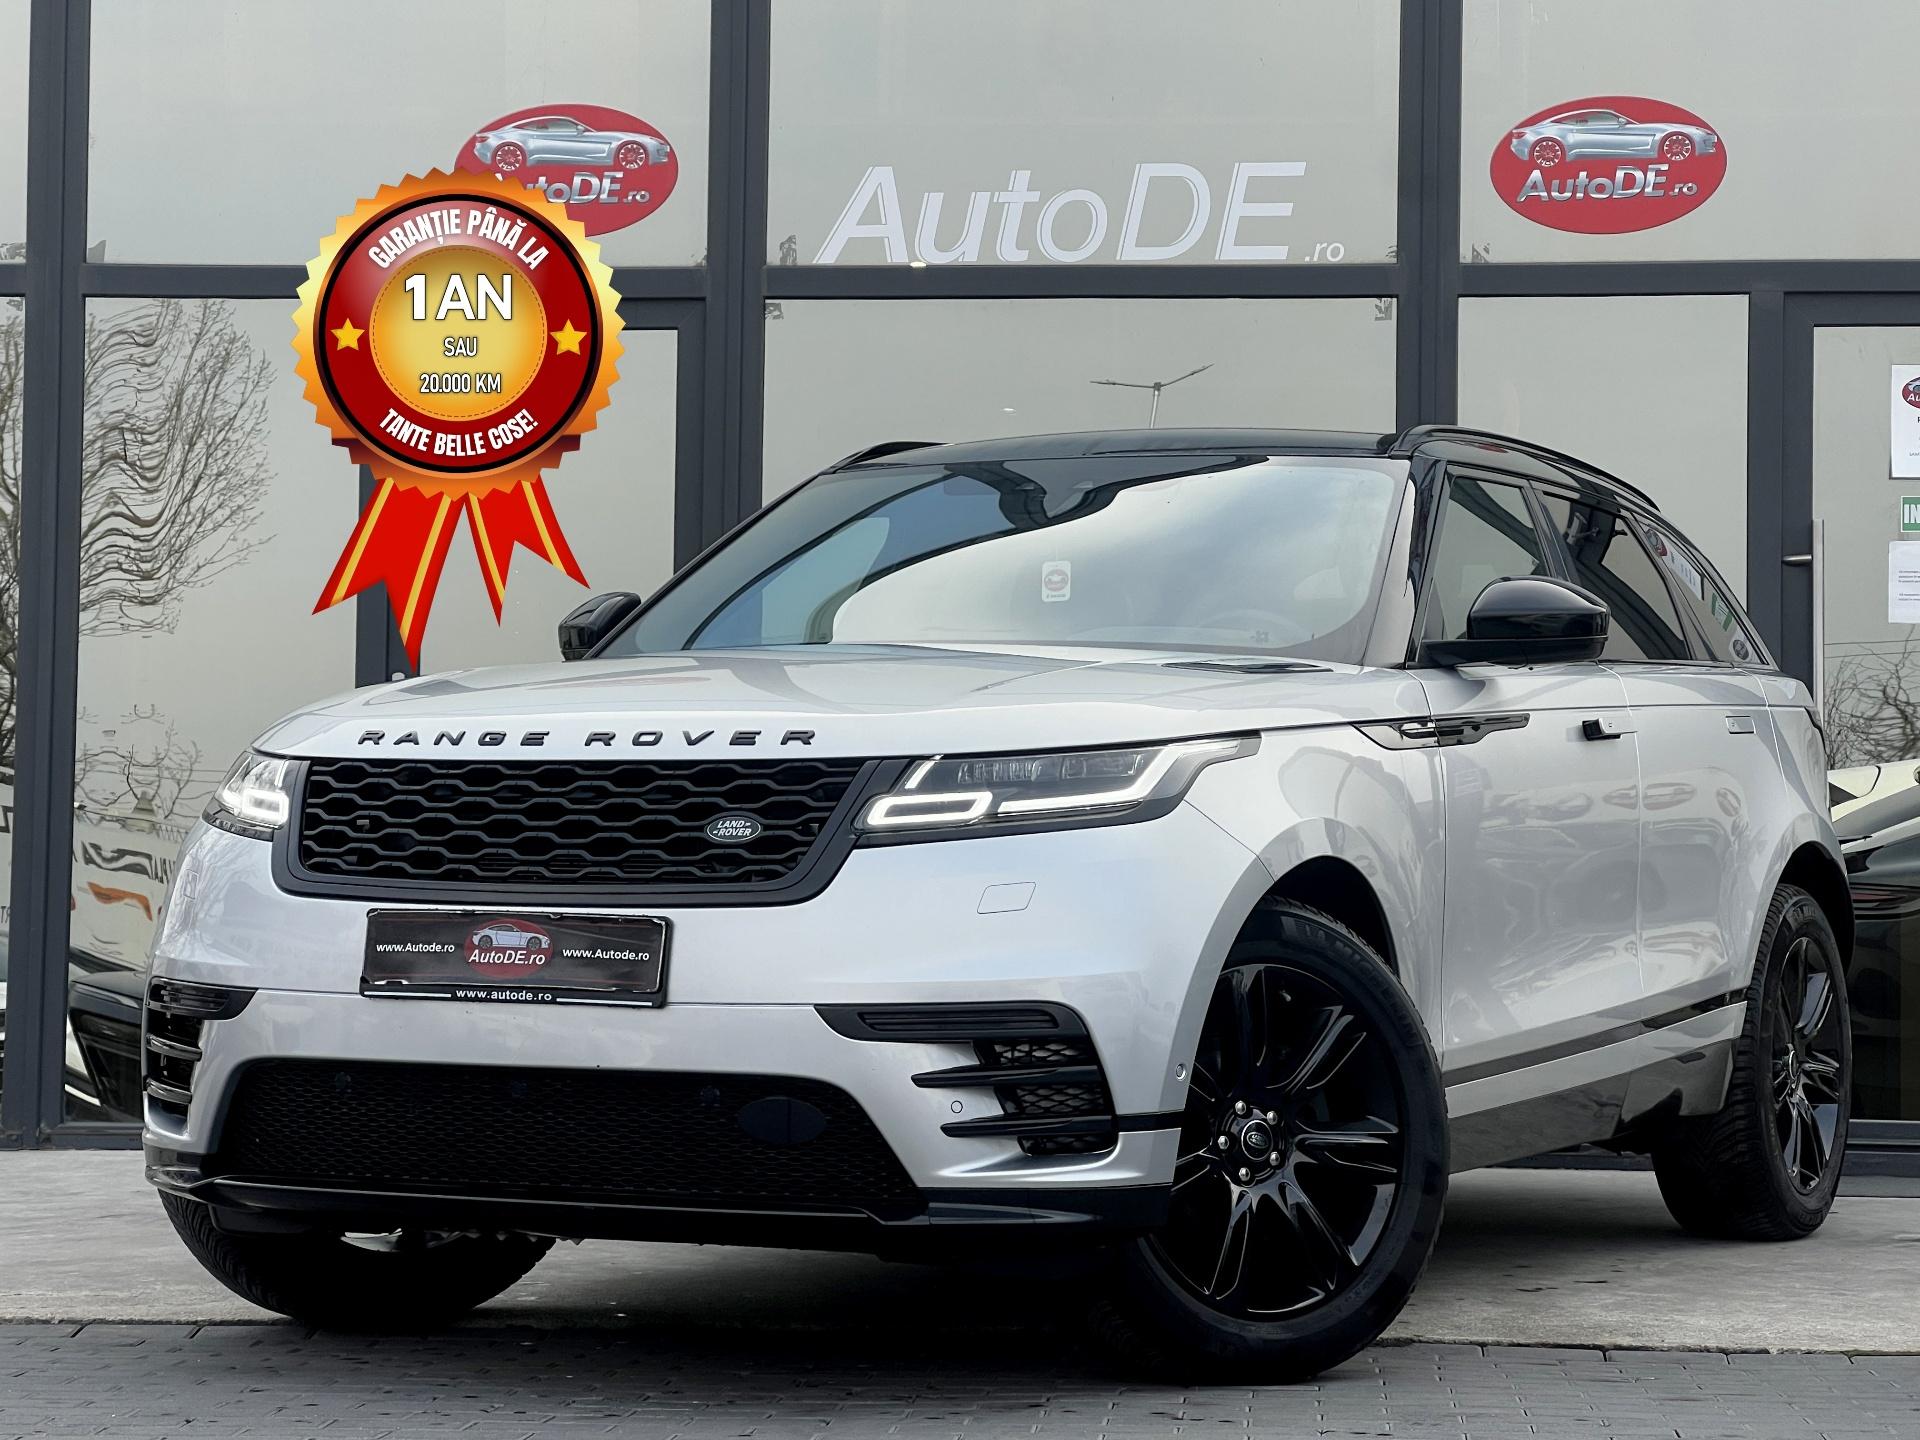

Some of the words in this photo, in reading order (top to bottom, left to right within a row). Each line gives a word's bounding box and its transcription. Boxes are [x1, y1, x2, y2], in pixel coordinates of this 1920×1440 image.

[357, 730, 550, 747] RANGE
[584, 729, 816, 747] ROVER
[376, 941, 455, 953] www.Autode.ro
[468, 949, 545, 965] AutoDE.ro
[562, 948, 650, 962] www.Autode.ro
[456, 988, 552, 1001] www.autode.ro
